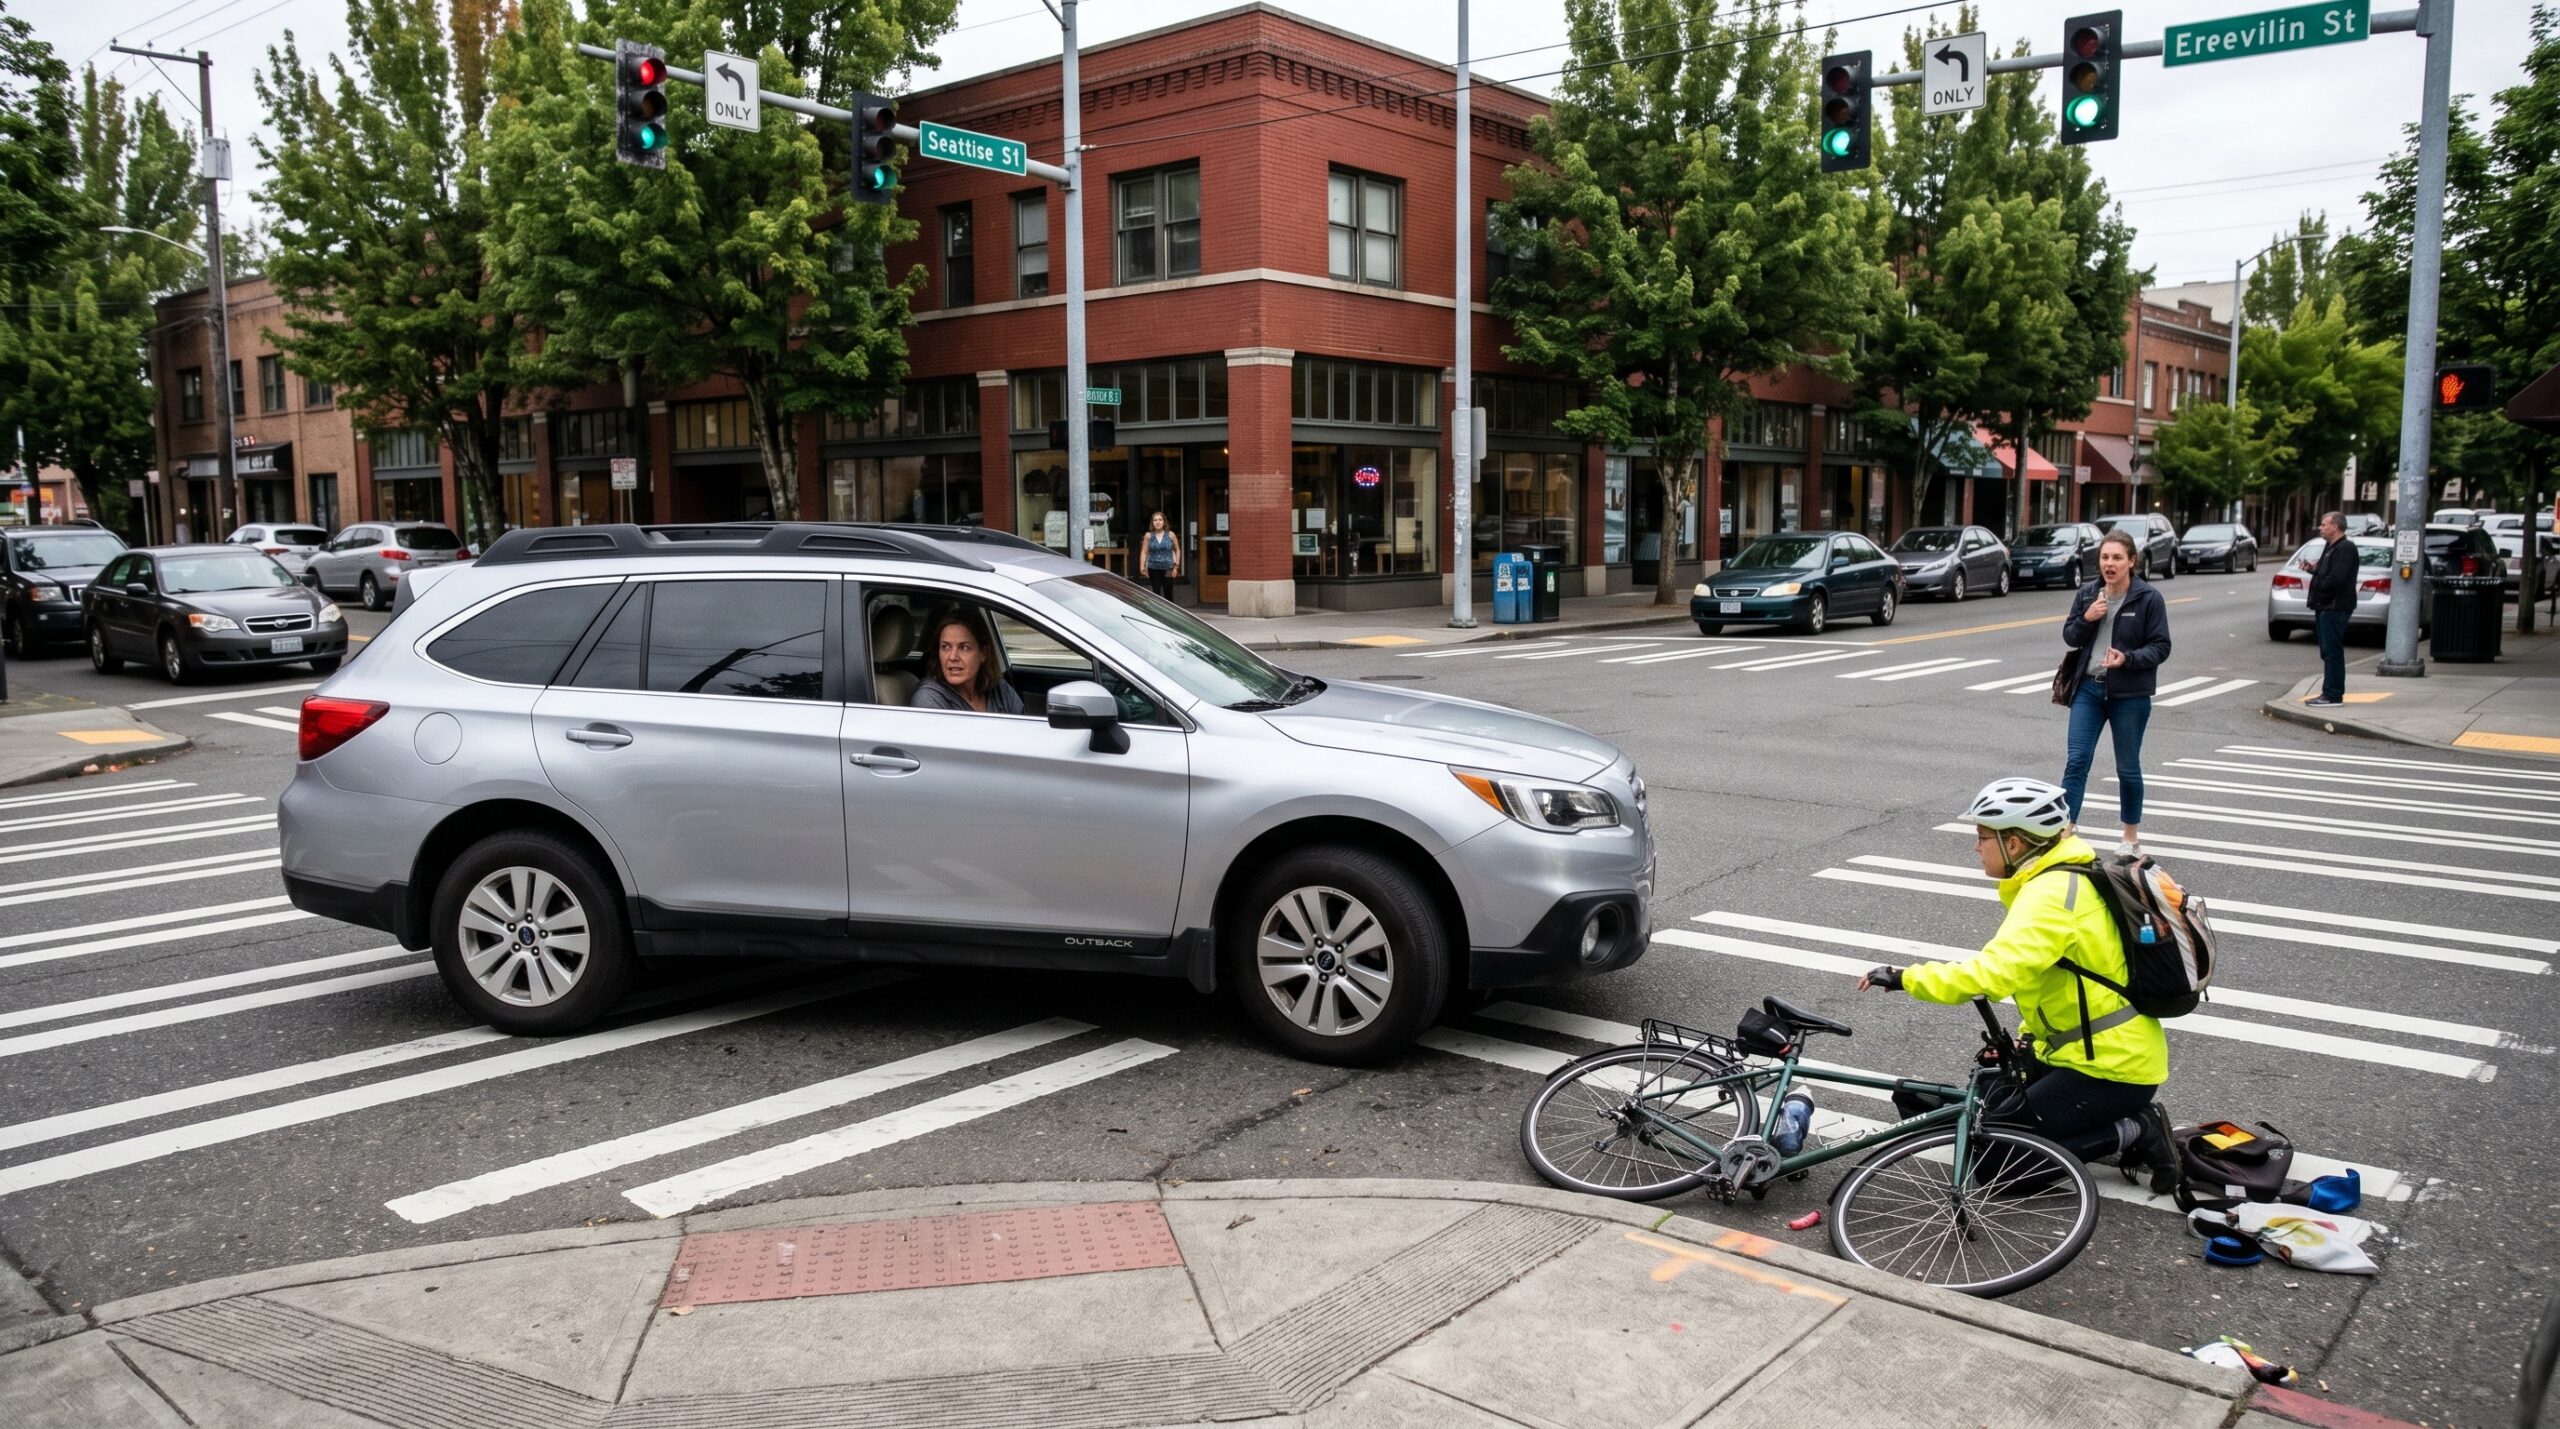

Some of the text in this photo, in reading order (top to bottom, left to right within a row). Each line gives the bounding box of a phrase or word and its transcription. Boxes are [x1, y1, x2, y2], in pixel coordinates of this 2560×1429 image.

[2176, 8, 2356, 58] Ereevilin St
[1933, 85, 1974, 106] ONLY
[715, 101, 751, 121] ONLY
[928, 130, 994, 162] Seattise
[1064, 936, 1133, 948] OUTBACK
